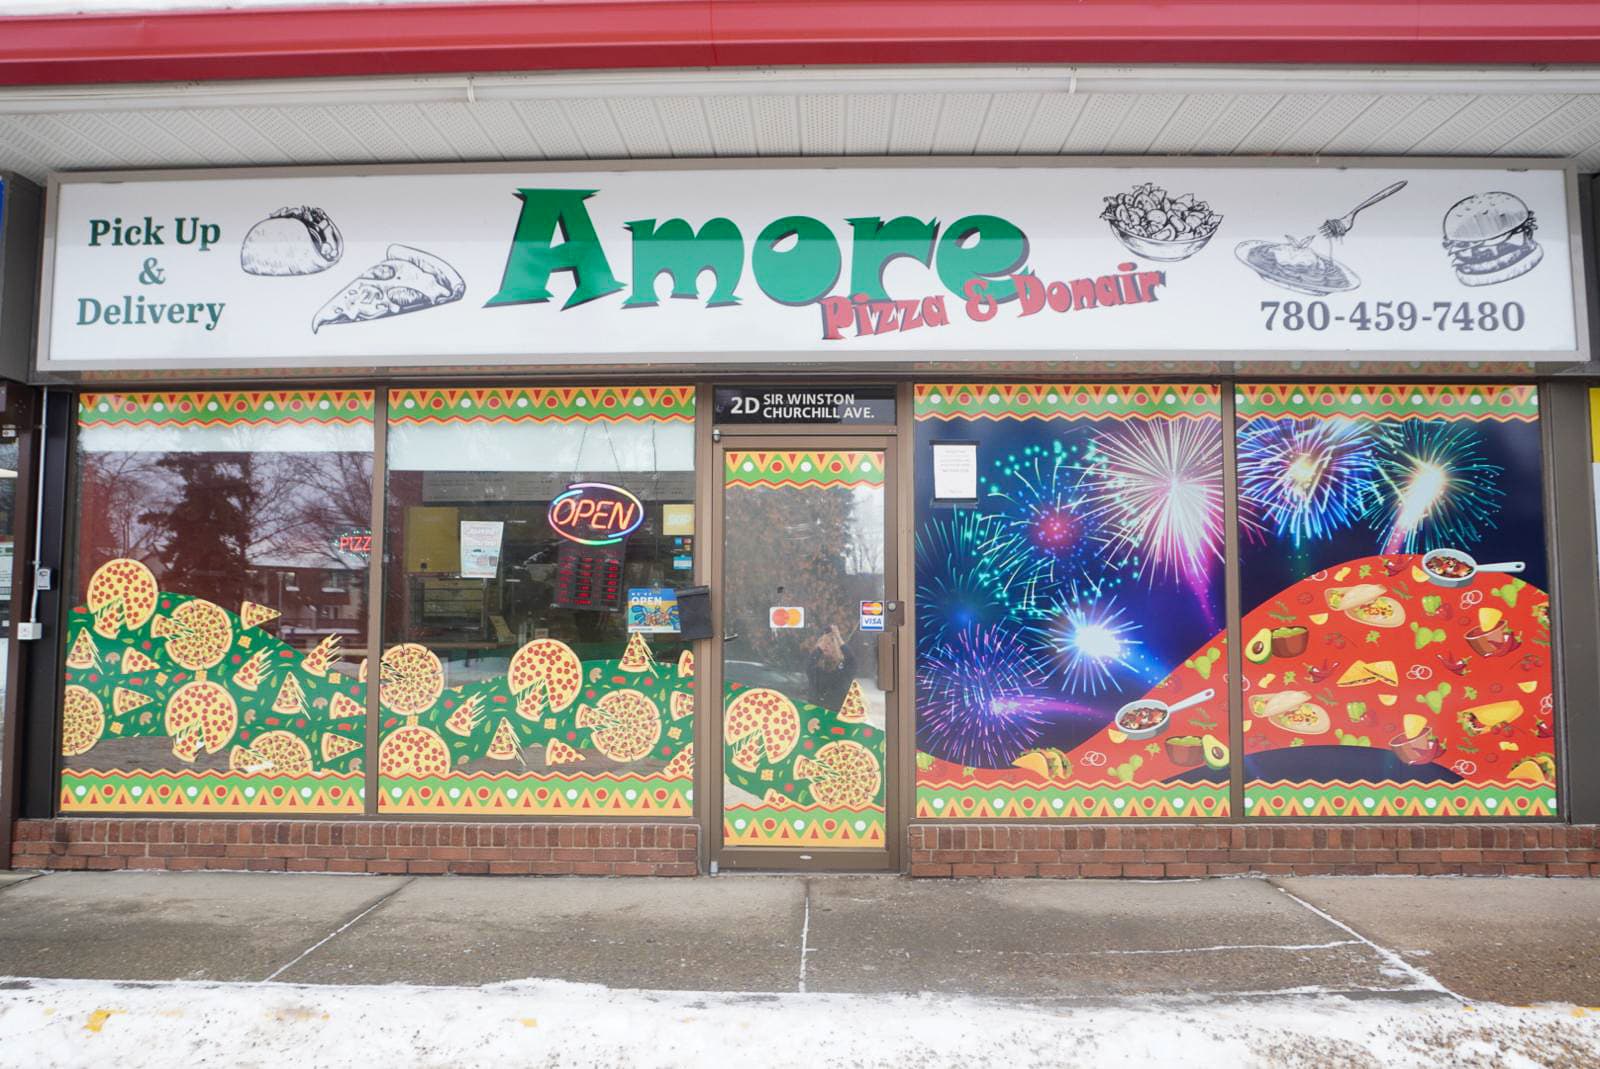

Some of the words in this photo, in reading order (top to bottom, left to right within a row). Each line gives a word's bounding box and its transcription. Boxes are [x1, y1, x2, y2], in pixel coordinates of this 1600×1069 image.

[88, 217, 165, 247] Pick
[174, 216, 221, 251] Up
[481, 188, 1032, 311] Amore
[138, 257, 166, 285] &
[76, 295, 226, 331] Delivery
[820, 292, 950, 341] Pizza
[964, 278, 999, 323] &
[1017, 261, 1167, 318] Donair
[1259, 300, 1526, 332] 780-459-7480
[730, 396, 760, 415] 2D
[763, 393, 784, 405] SIR
[787, 393, 855, 405] WINSTON
[763, 406, 840, 419] CHURCHILL
[843, 406, 875, 419] AVE.
[553, 498, 635, 530] OPEN
